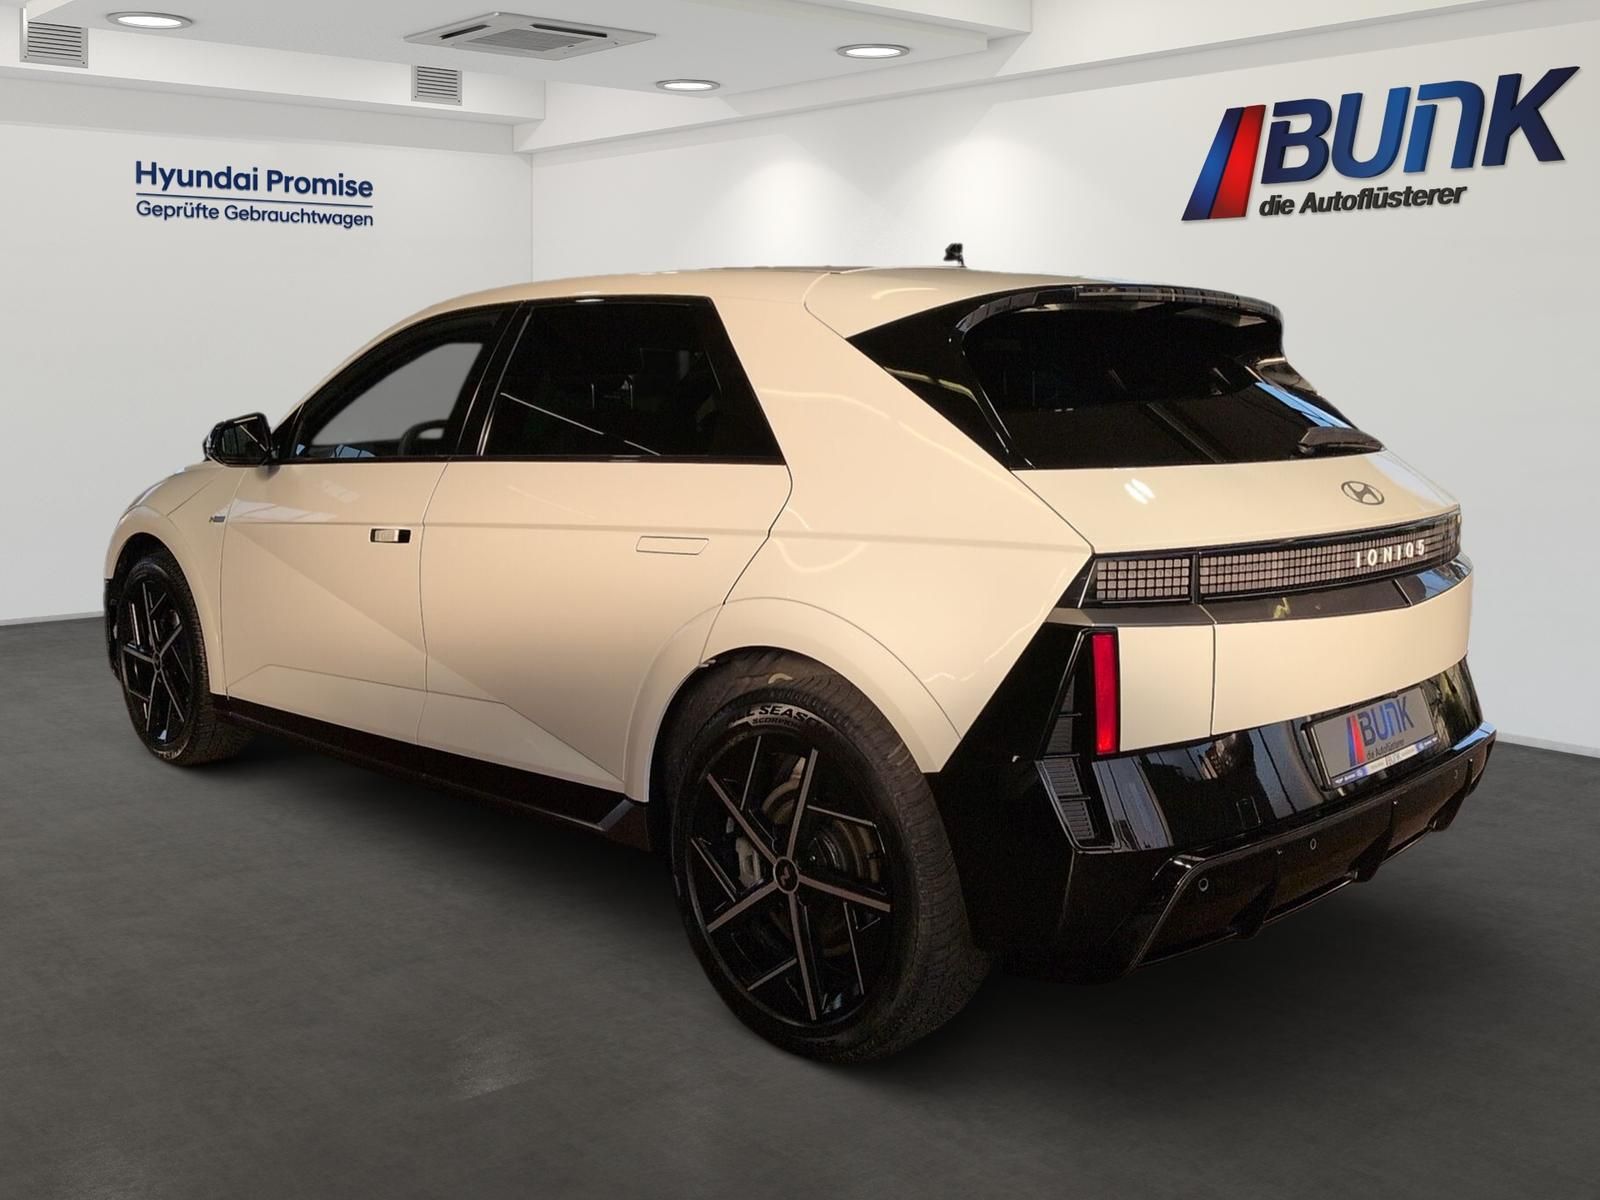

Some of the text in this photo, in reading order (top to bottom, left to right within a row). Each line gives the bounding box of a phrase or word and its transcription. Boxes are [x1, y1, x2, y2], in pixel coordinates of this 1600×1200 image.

[1261, 66, 1580, 184] BUNK
[136, 161, 373, 198] Hyundai Promise
[136, 200, 373, 229] Geprüfte Gebrauchtwagen
[1259, 185, 1467, 216] die Autoflüsterer
[1357, 696, 1415, 747] BUNK
